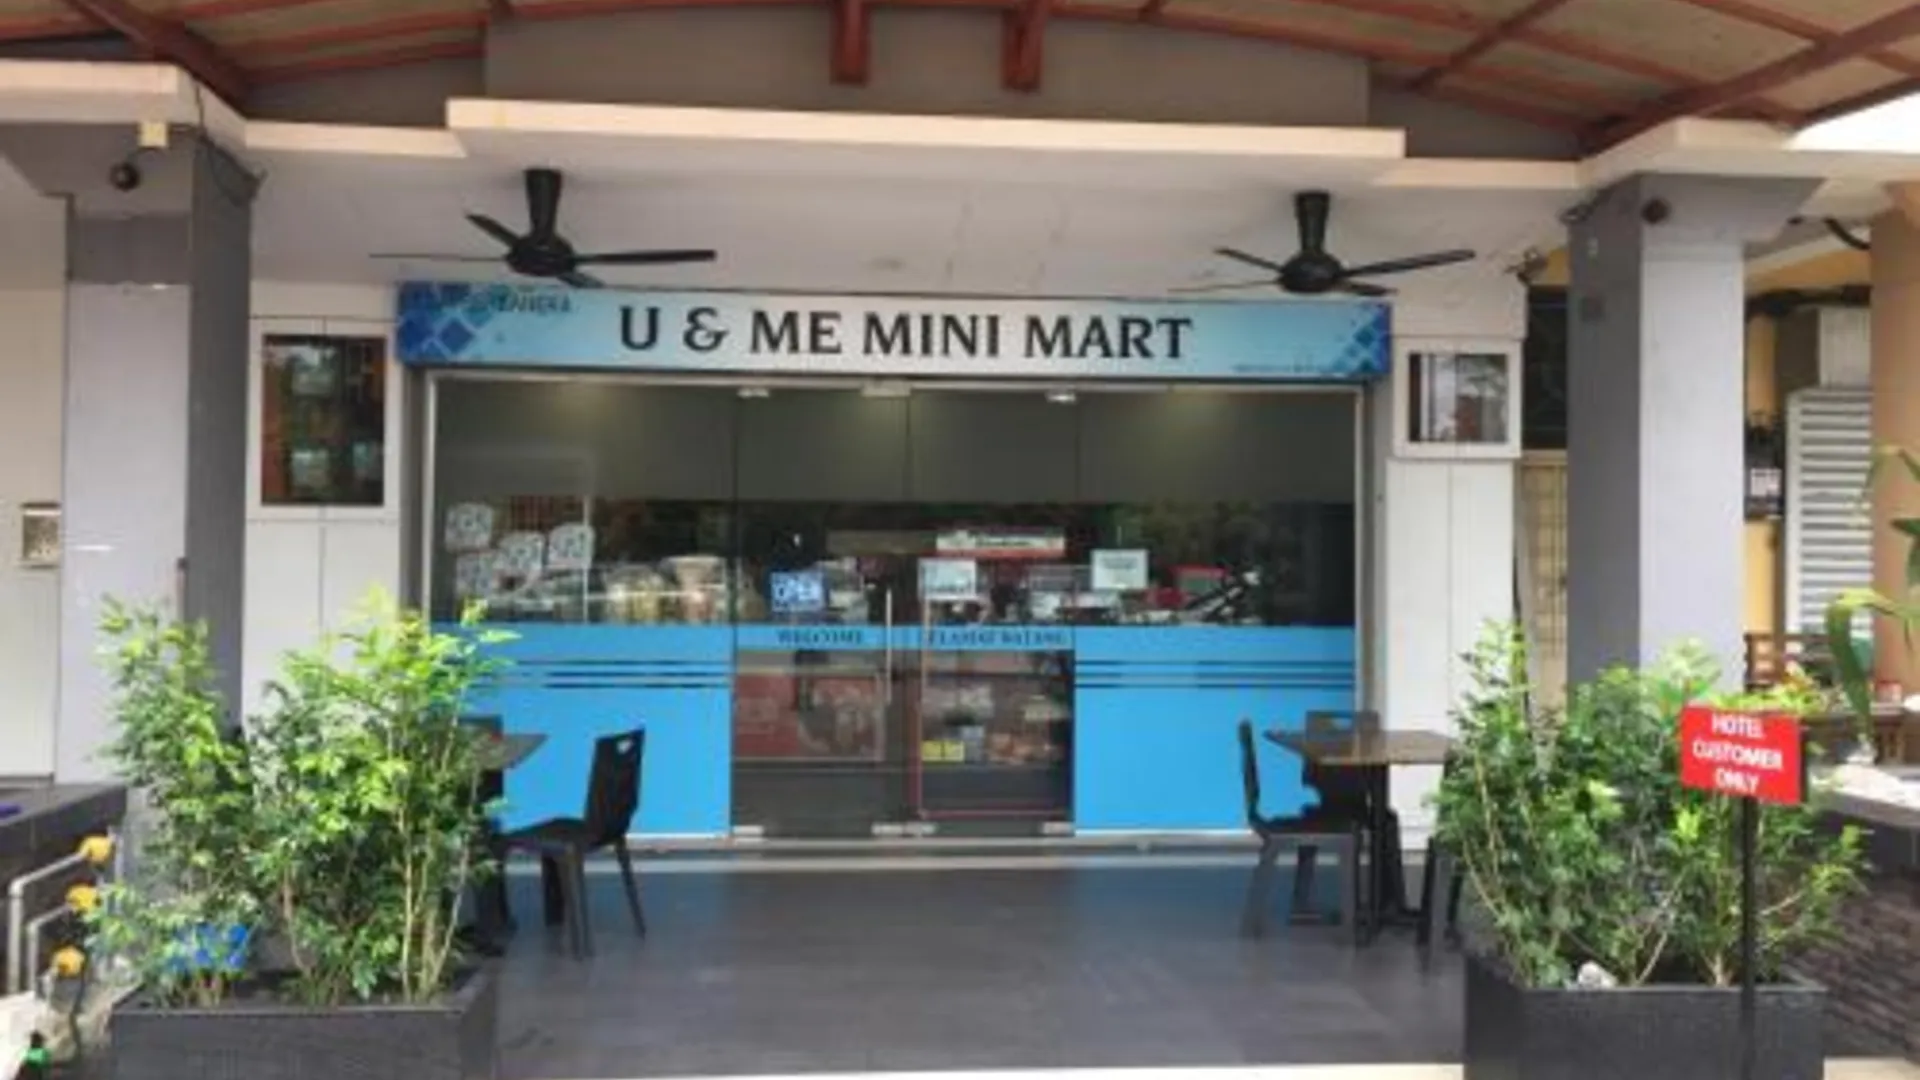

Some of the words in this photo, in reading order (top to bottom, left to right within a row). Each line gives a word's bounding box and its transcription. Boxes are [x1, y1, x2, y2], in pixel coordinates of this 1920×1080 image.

[619, 304, 660, 350] U
[683, 306, 730, 352] &
[750, 310, 842, 354] ME
[863, 311, 1000, 357] MINI
[1024, 313, 1193, 358] MART
[776, 628, 864, 645] WELCOME
[1711, 711, 1765, 739] HOTEL
[1692, 737, 1783, 771] CUSTOMER
[1714, 766, 1760, 795] ONLY
